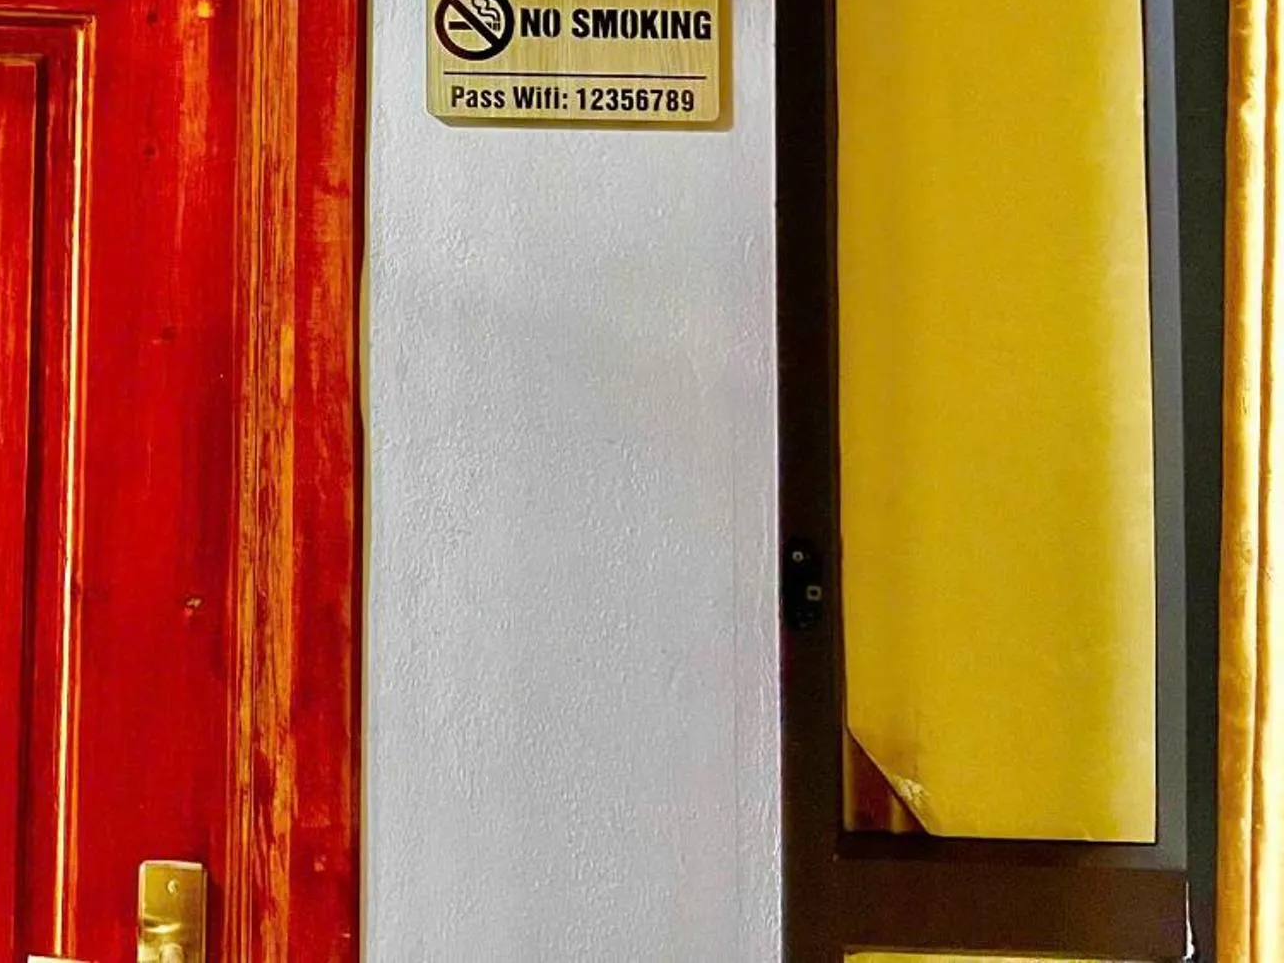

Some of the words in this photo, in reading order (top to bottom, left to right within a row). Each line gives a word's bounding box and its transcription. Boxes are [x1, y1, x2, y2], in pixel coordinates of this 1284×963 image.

[520, 8, 560, 37] NO
[572, 8, 711, 40] SMOKING
[451, 85, 505, 108] Pass
[513, 86, 568, 110] Wifi:
[576, 89, 695, 112] 12356789
